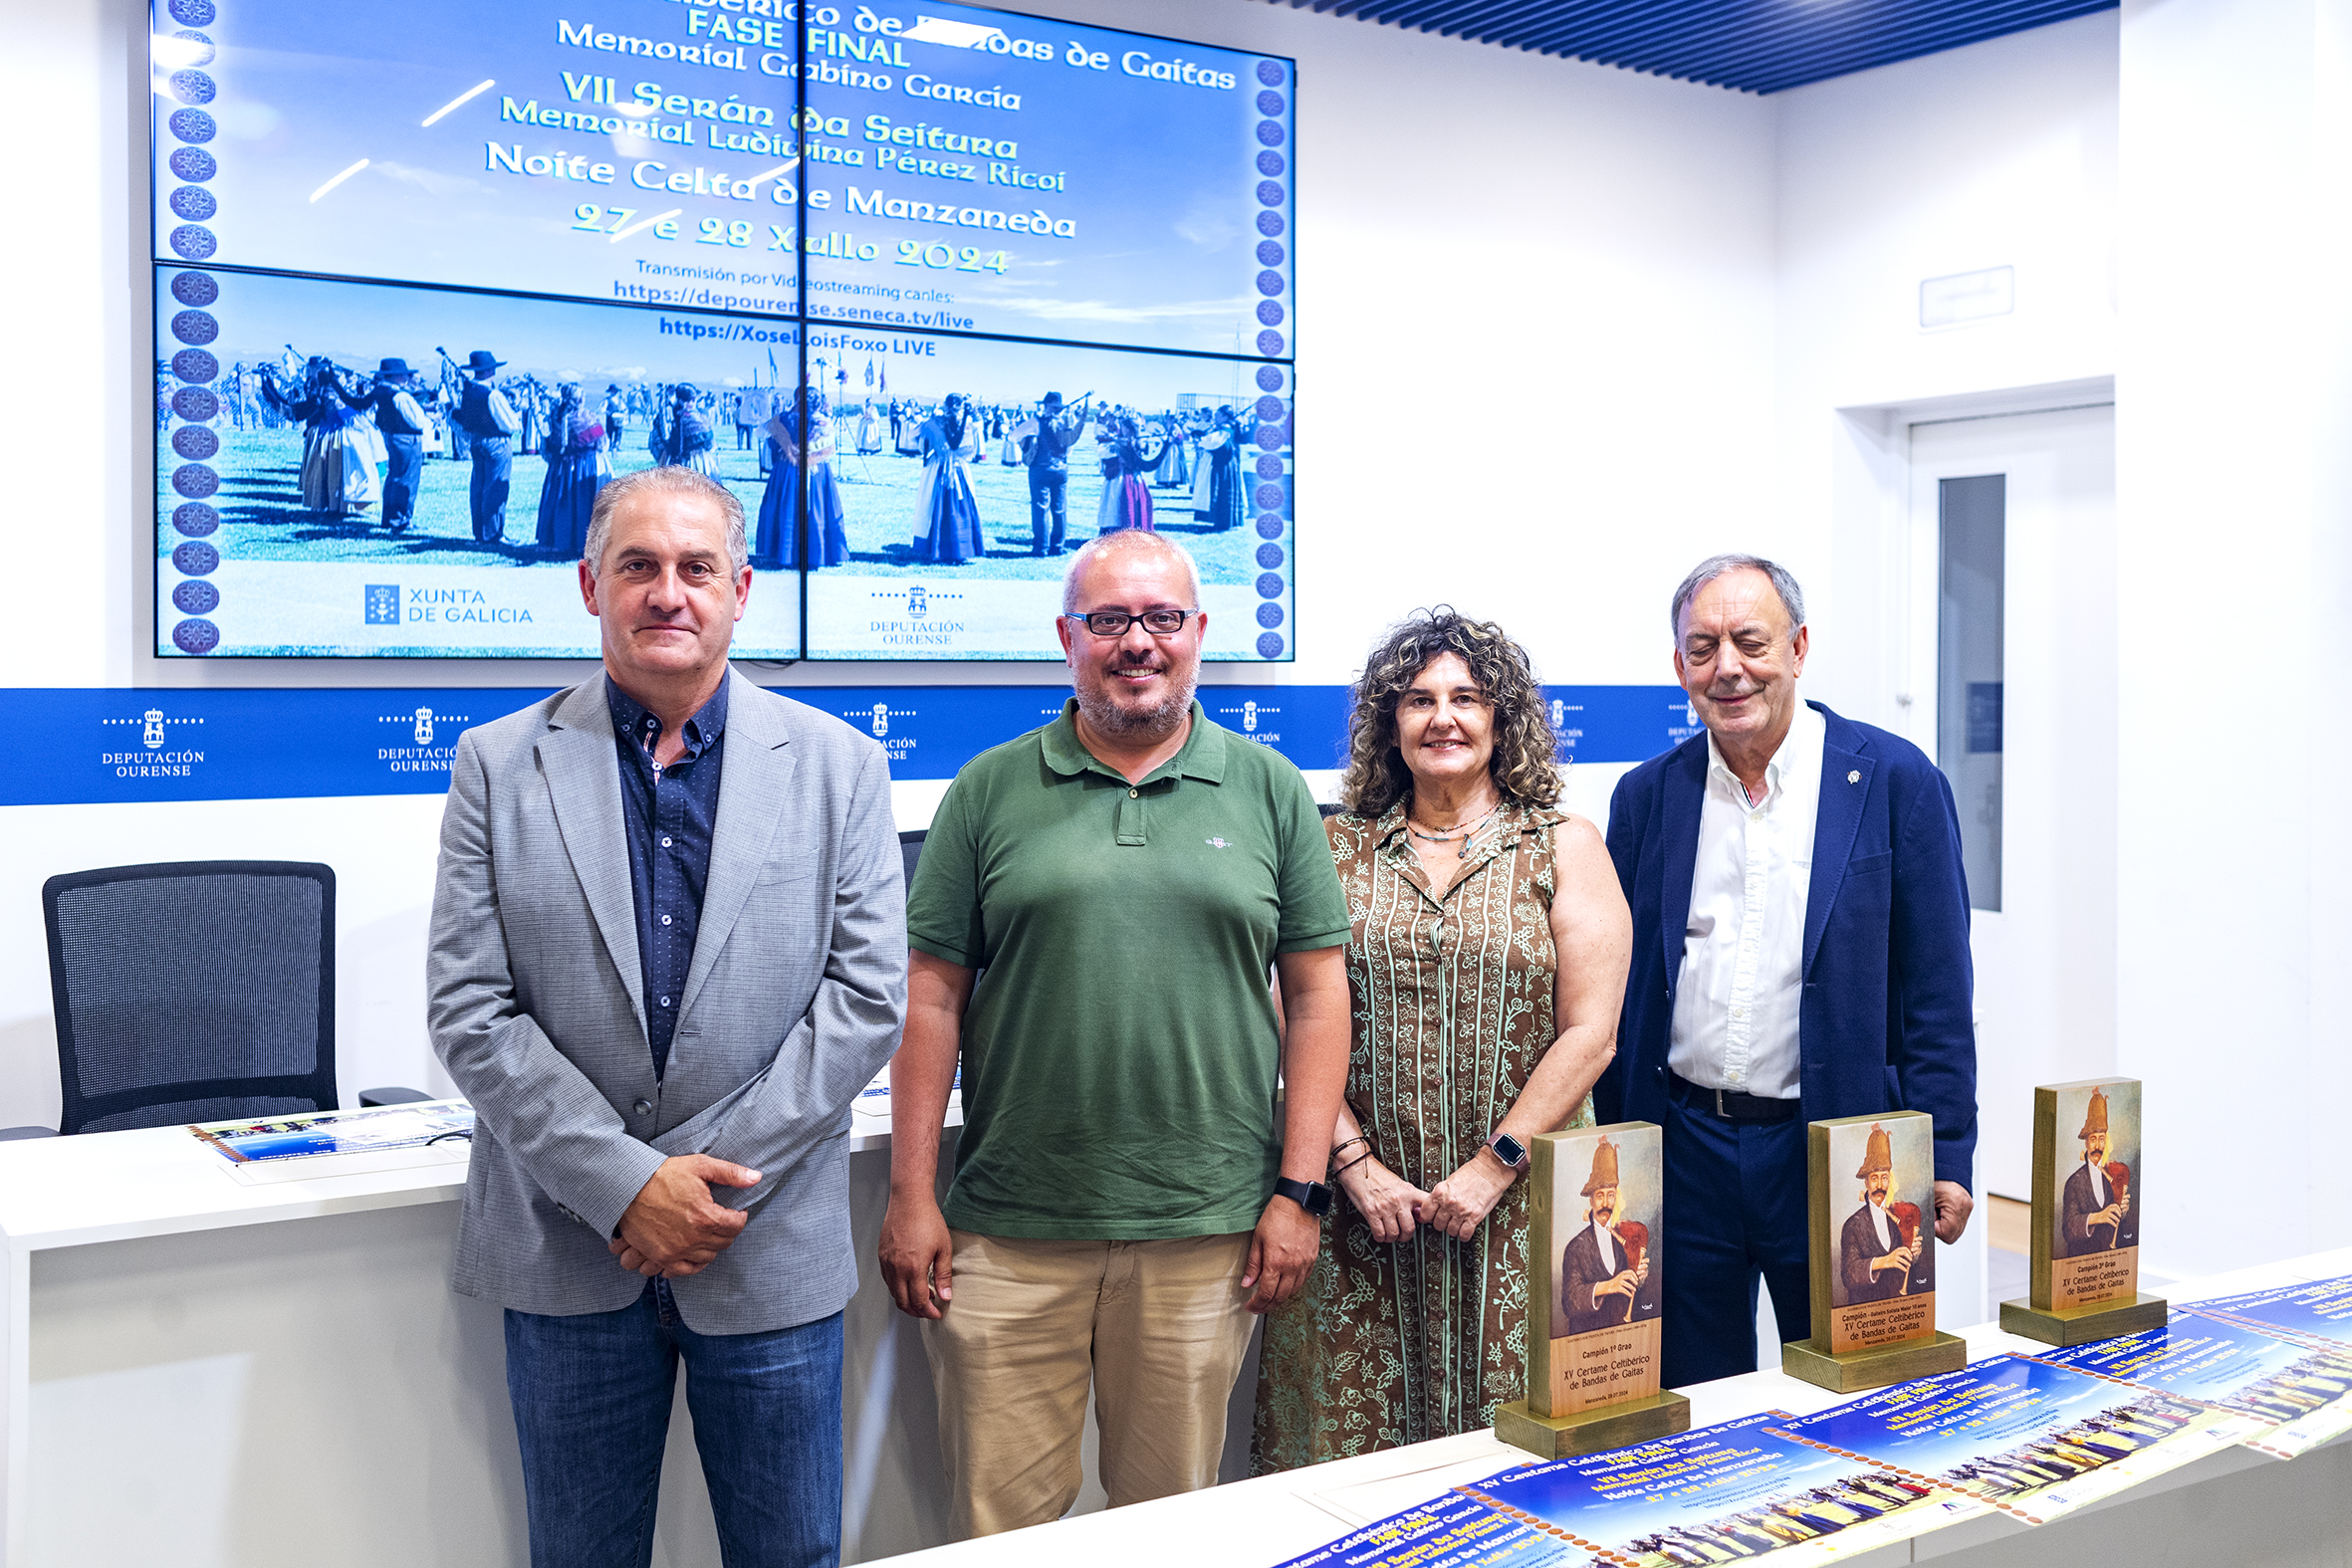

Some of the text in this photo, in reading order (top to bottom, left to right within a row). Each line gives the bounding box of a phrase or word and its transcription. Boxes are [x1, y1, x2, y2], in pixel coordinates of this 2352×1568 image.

[687, 8, 911, 69] FASE FINAL
[853, 5, 903, 38] de
[1064, 41, 1110, 72] de
[1121, 50, 1237, 91] Gaitas
[557, 18, 1022, 112] Memorial Gabino García
[562, 71, 1019, 161] VII Serán da Seitura
[501, 96, 1066, 193] Memorial Ludivina Pérez Ricoi
[484, 141, 1077, 239] Noite Celta de Manzaneda
[571, 203, 1010, 275] 27 e 28 Xullo 2024
[635, 259, 955, 305] Transmisión por Videostreaming canles:
[613, 280, 975, 330] https://depourense.seneca.tv/live
[892, 338, 936, 357] LIVE
[409, 588, 486, 604] XUNTA
[409, 606, 534, 623] DE GALICIA
[870, 619, 965, 633] DEPUTACIÓN
[882, 634, 953, 645] OURENSE
[378, 744, 458, 761] DEPUTACIÓ
[882, 737, 917, 750] ACIÓN
[102, 749, 205, 765] DEPUTACIÓN
[116, 765, 191, 779] OURENSE
[2062, 1268, 2130, 1287] XV Certame Celtibérico
[2077, 1263, 2098, 1273] Campión
[2066, 1287, 2075, 1296] de
[2076, 1283, 2097, 1294] Bandas
[2107, 1278, 2125, 1288] Gaitas
[1842, 1311, 1868, 1323] Campión
[1844, 1310, 1926, 1332] XV Certame Celtibérico
[1850, 1321, 1920, 1341] de Bandas de Gaitas
[1582, 1346, 1609, 1360] Campión
[1617, 1343, 1632, 1352] Grao
[1563, 1354, 1651, 1381] XV Certame Celtibérico
[1569, 1366, 1644, 1391] de Bandas de Gaitas
[1782, 1421, 1803, 1431] XV
[1939, 1428, 1958, 1438] 27
[1704, 1452, 1784, 1477] Manzaneda
[1477, 1478, 1501, 1491] XV
[1502, 1461, 1569, 1483] Certame
[1645, 1492, 1666, 1503] 27
[1475, 1525, 1531, 1551] Manzan
